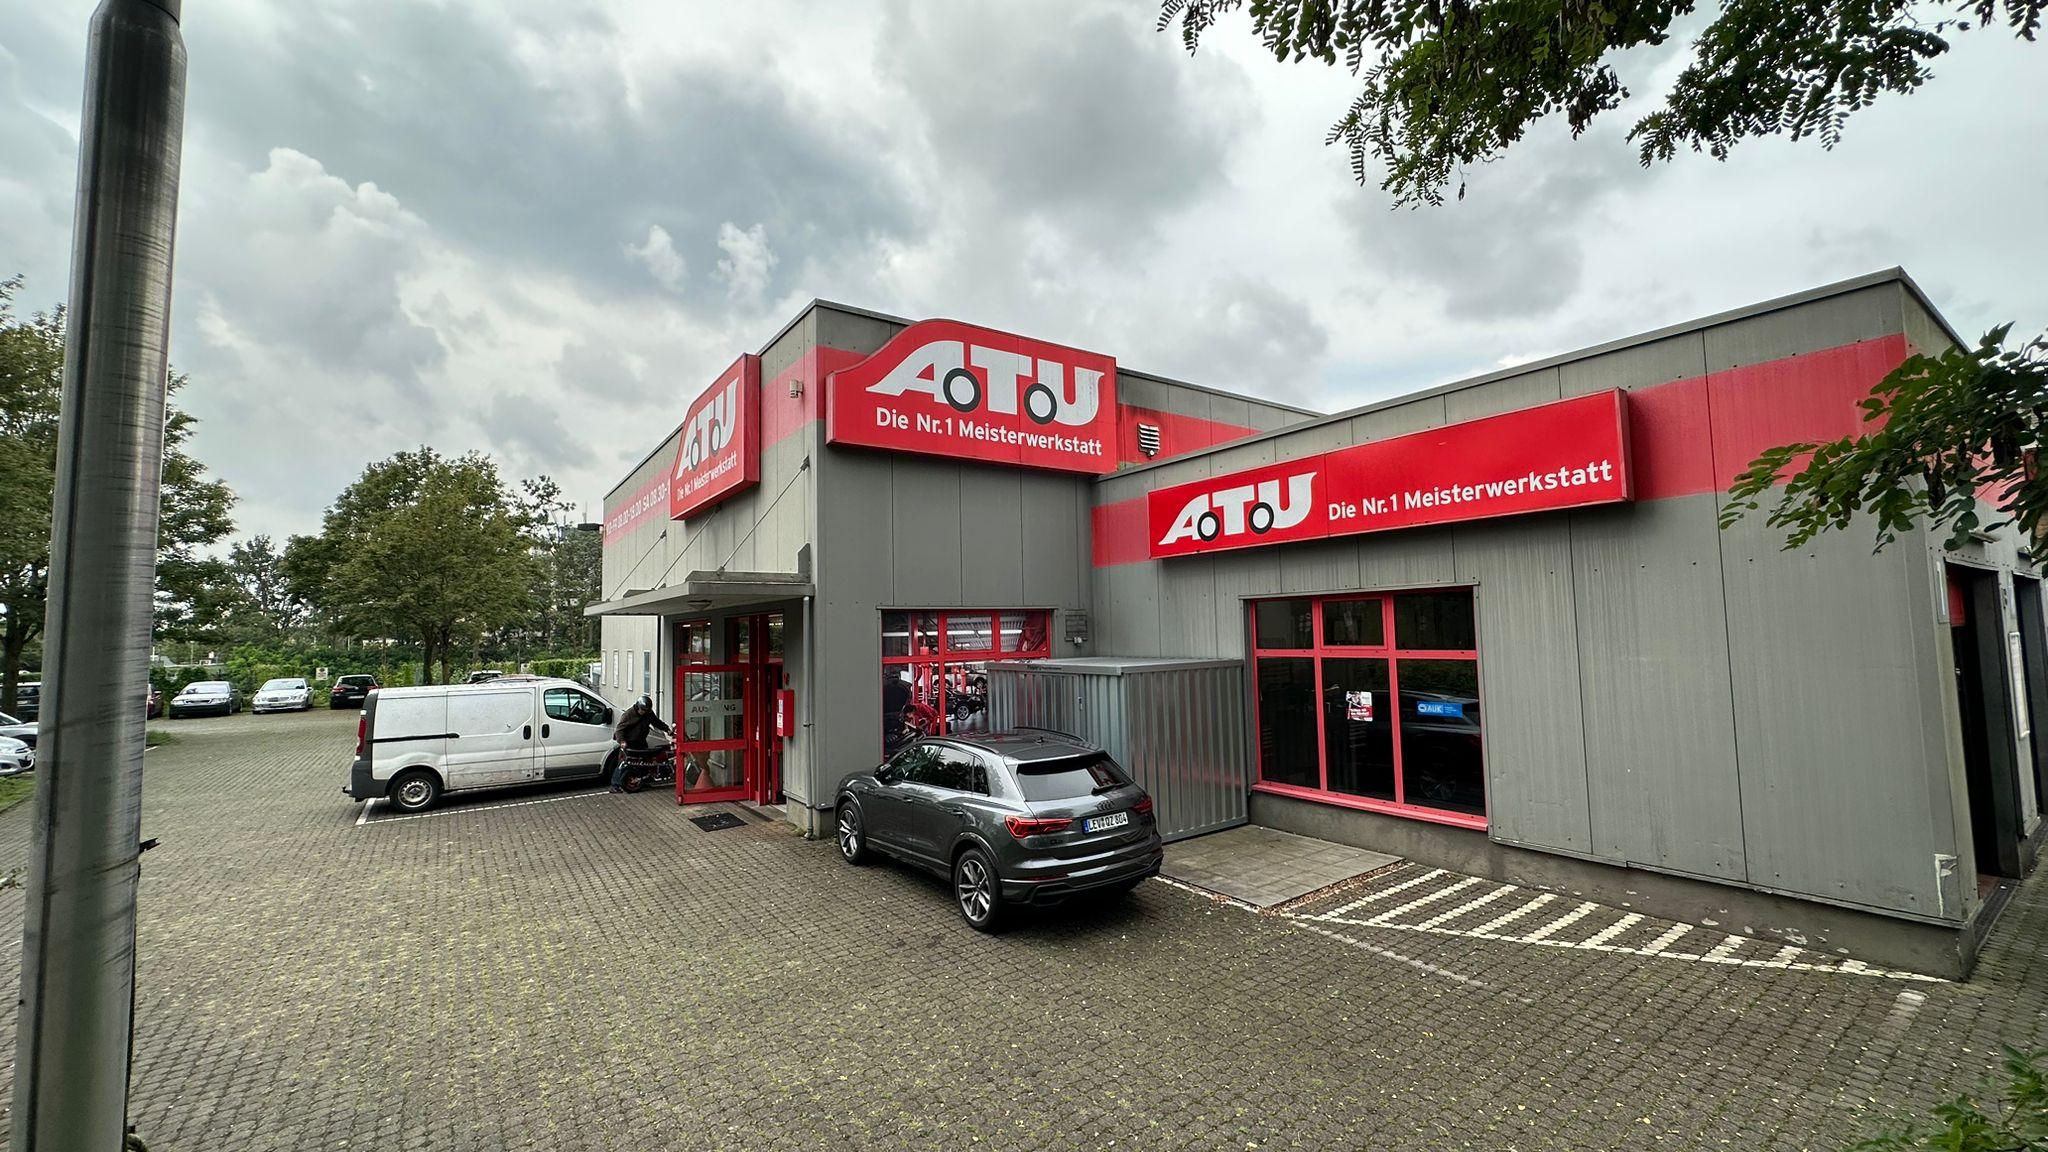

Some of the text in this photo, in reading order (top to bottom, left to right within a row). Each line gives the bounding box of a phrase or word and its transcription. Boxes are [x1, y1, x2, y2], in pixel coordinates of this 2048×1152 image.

[866, 340, 1104, 426] ATU
[676, 377, 739, 480] ATU
[876, 407, 909, 429] Die
[959, 419, 1102, 456] Meisterwerkstatt
[693, 450, 738, 490] Meisterwerkstatt
[1328, 503, 1356, 521] Die
[1404, 459, 1613, 510] Meisterwerkstatt
[1158, 471, 1317, 545] ATU
